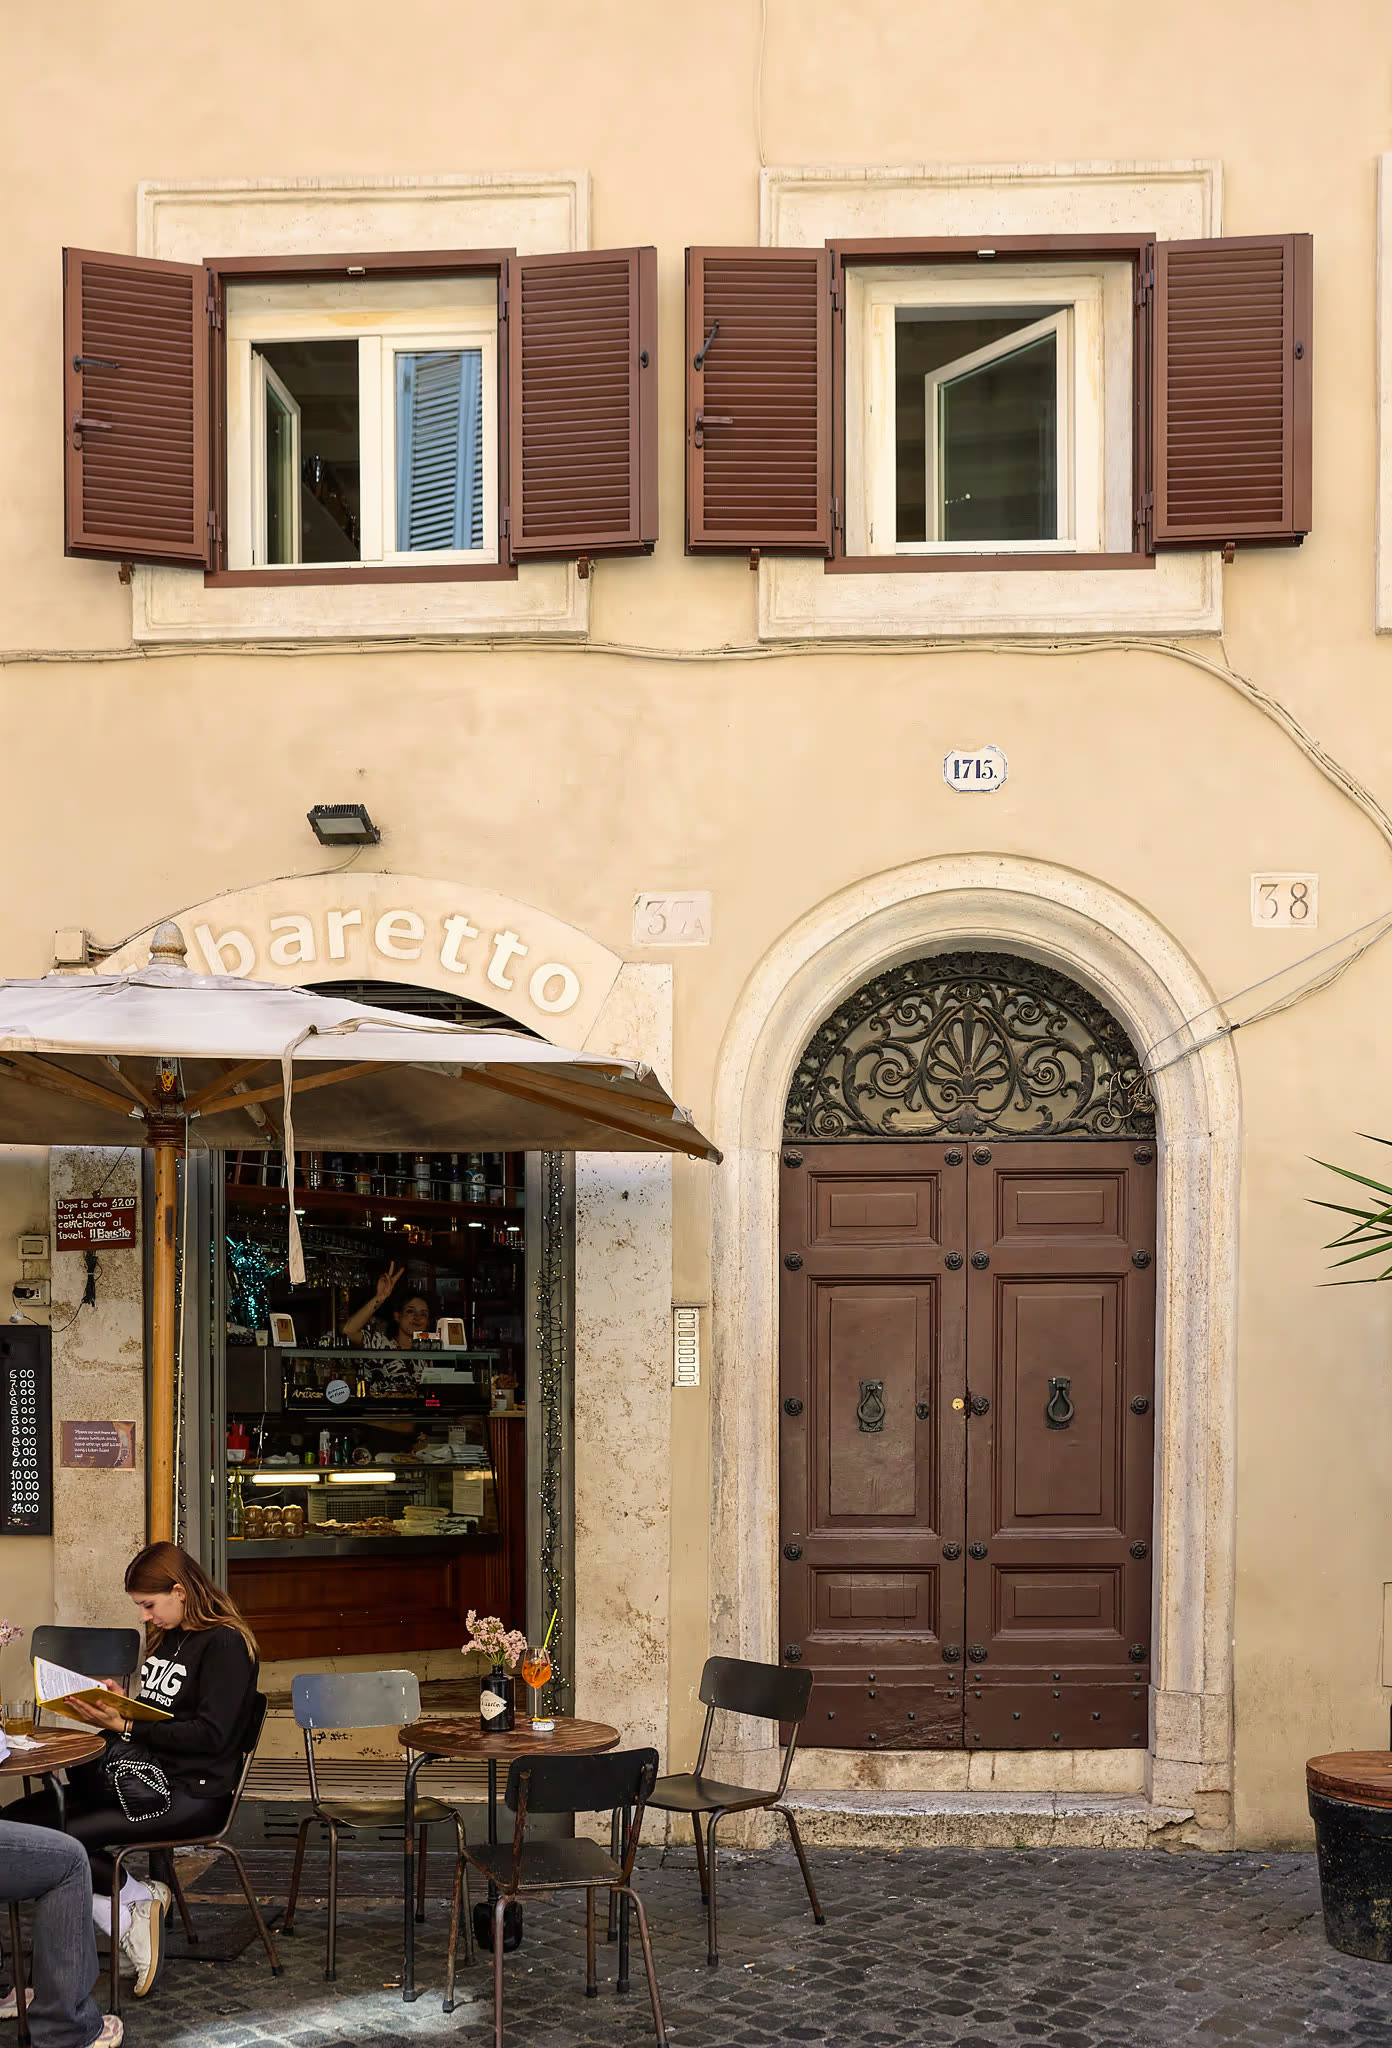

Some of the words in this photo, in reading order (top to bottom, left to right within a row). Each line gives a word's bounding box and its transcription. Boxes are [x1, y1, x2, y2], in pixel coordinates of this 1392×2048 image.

[1257, 881, 1310, 920] 38
[194, 906, 582, 1014] baretto
[12, 1458, 37, 1467] 6.00
